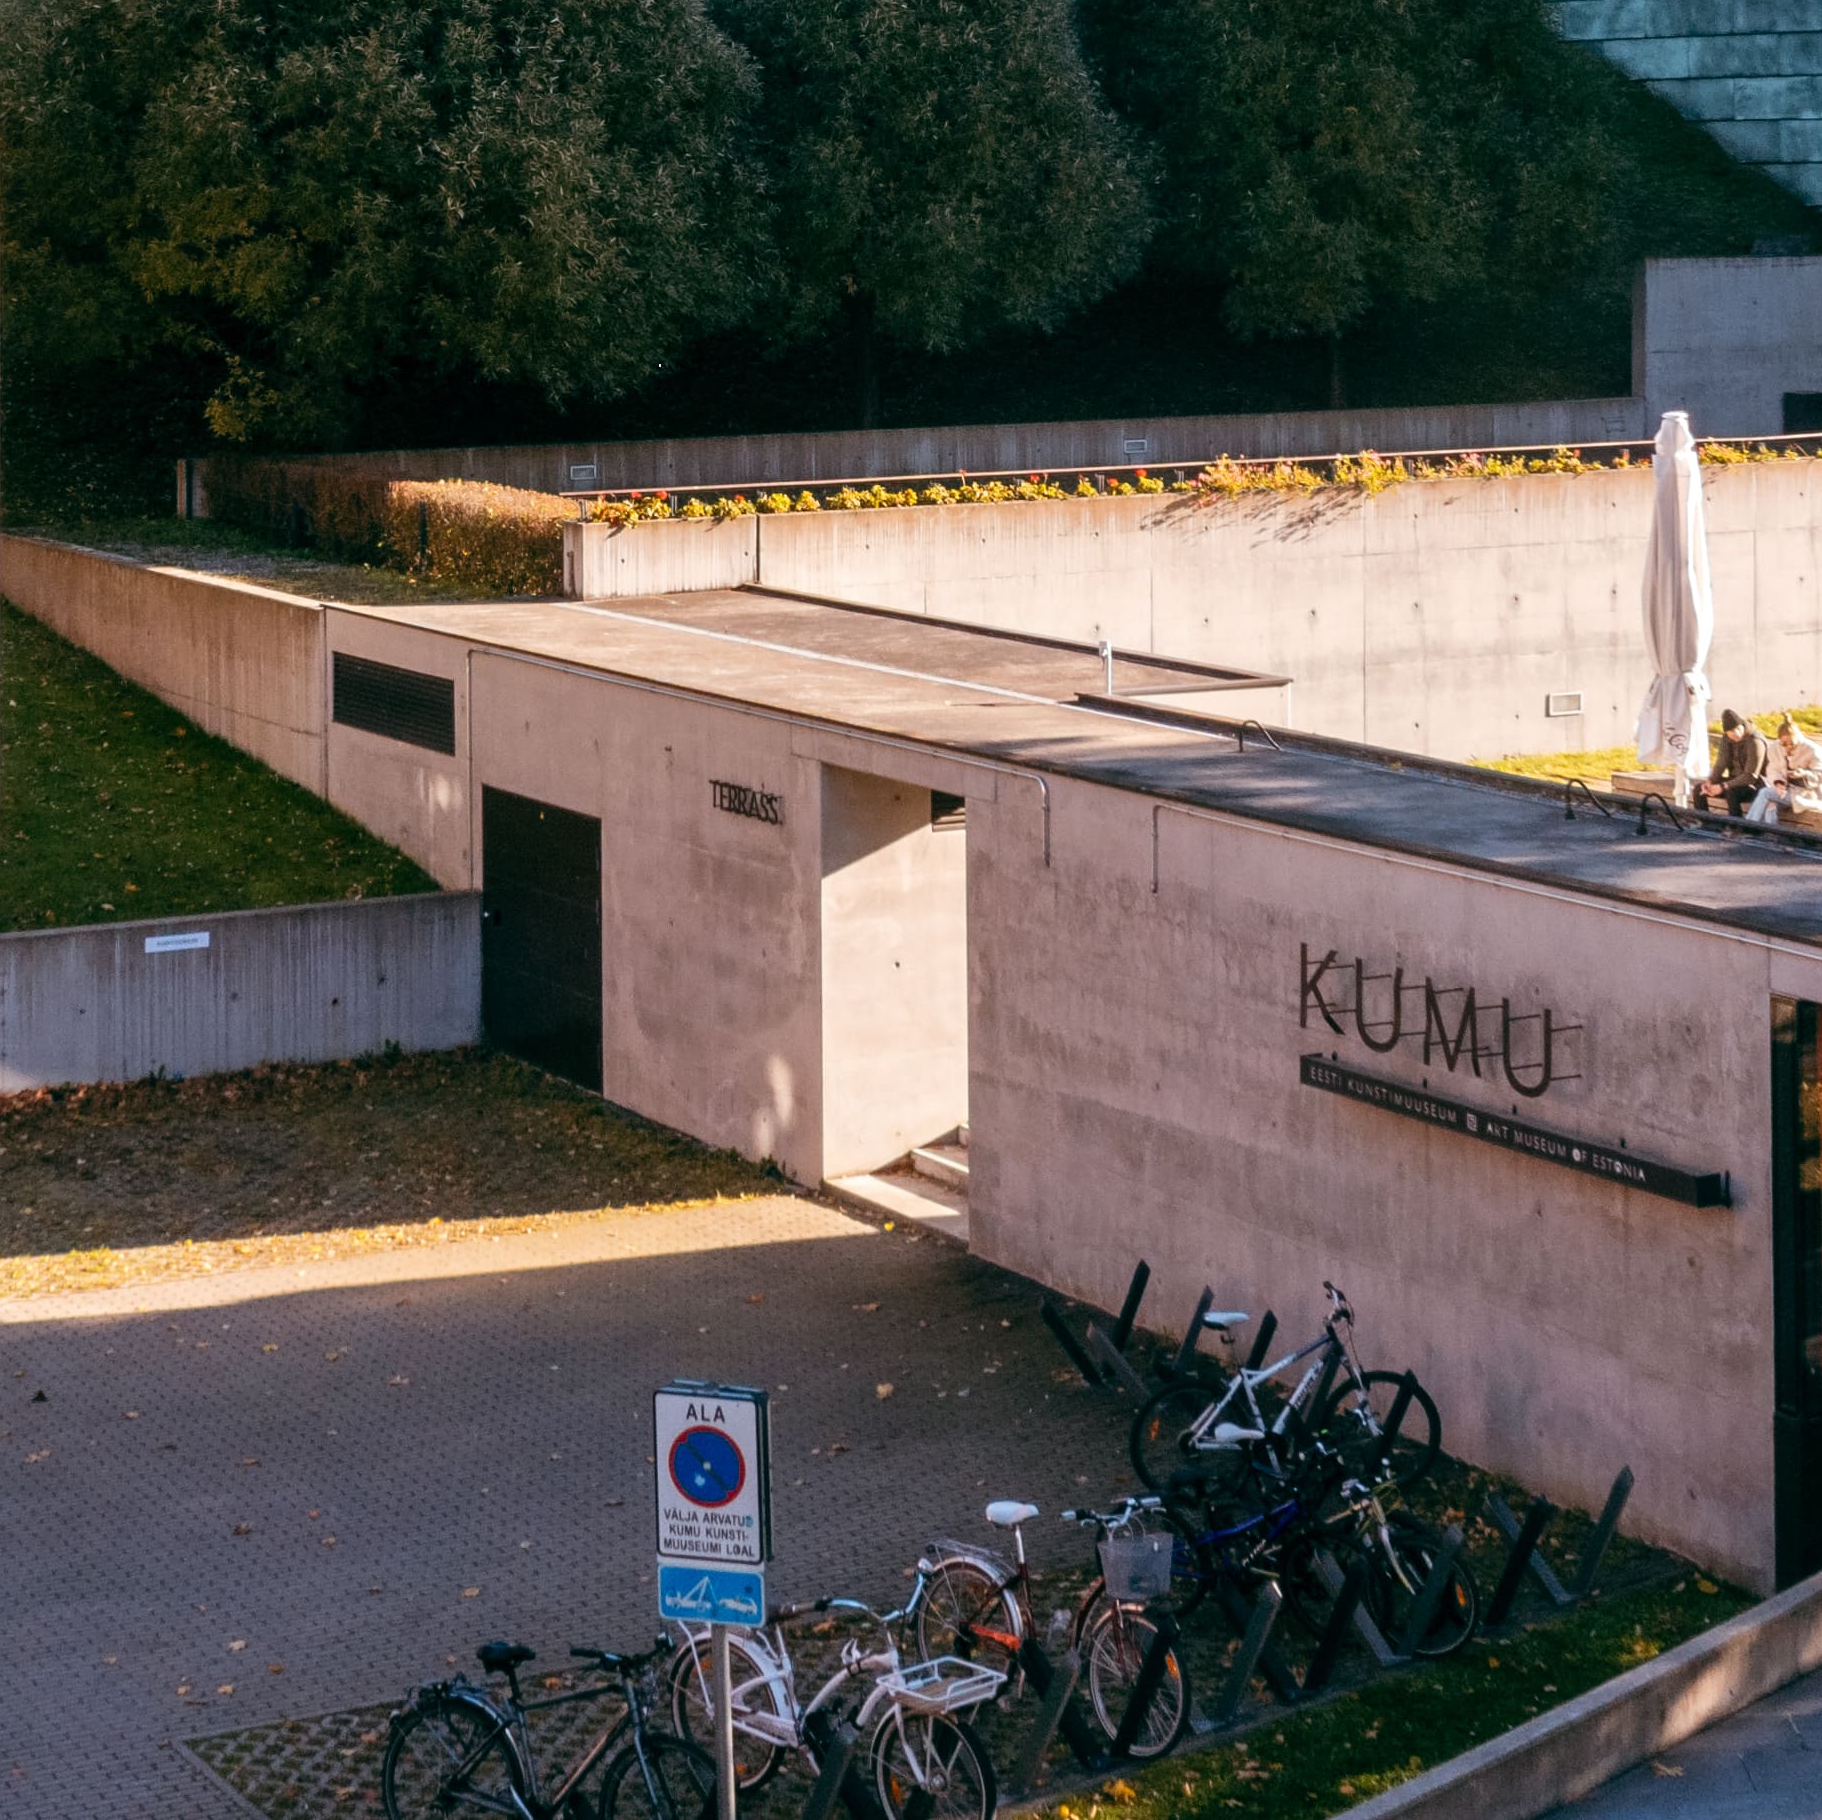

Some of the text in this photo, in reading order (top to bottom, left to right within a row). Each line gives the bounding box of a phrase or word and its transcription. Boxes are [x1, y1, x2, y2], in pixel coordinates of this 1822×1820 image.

[709, 779, 781, 826] TERRASS
[1300, 942, 1552, 1098] KUMU
[1310, 1066, 1646, 1182] EESTI KUNSTIMUUSEUM ART MUSEUM OF ESTONIA
[686, 1403, 726, 1423] ALA
[663, 1507, 699, 1523] VÄLJA
[669, 1524, 701, 1538] KUMU
[663, 1537, 755, 1557] MUUSEUMI LOAL
